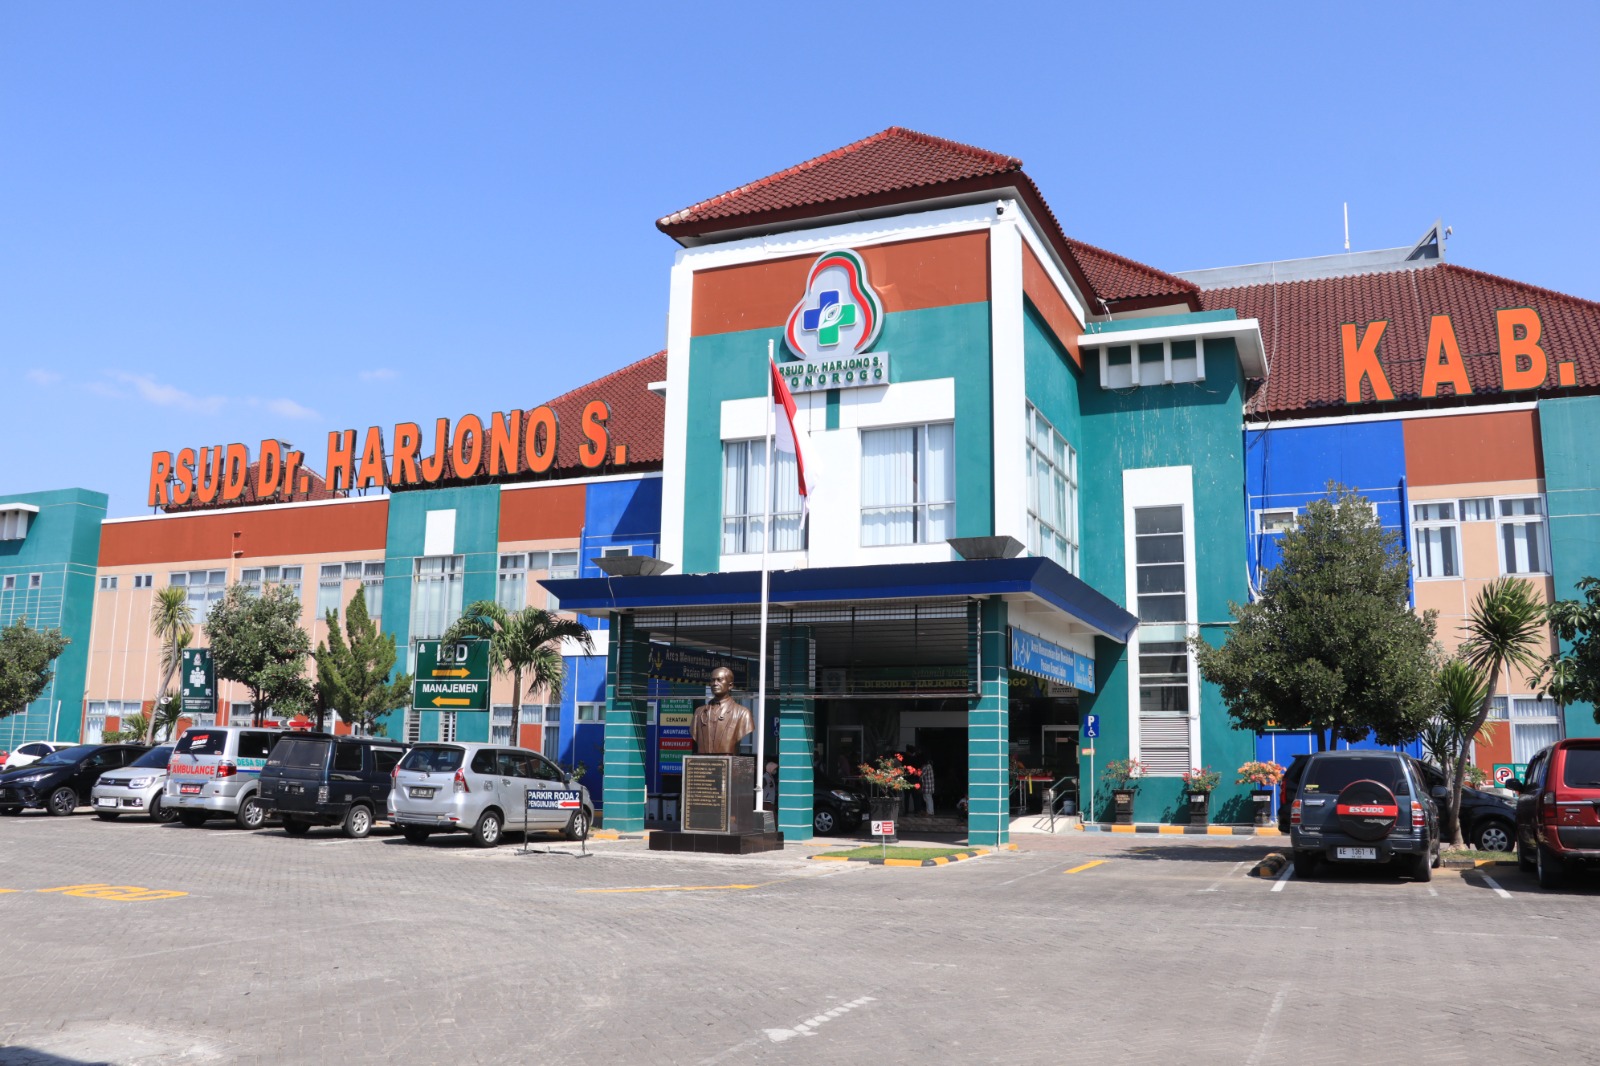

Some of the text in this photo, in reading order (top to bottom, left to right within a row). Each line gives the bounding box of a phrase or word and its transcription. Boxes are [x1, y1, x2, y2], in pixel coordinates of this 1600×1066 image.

[780, 356, 883, 377] RSUD Dr. HARJONO S.
[786, 368, 883, 387] ONOROGO
[148, 400, 629, 507] RSUD Dr. HARJONO S.
[422, 683, 478, 693] MANAJEMEN
[1088, 715, 1095, 727] P
[236, 758, 255, 767] DESA
[172, 764, 215, 775] AMBULANCE
[527, 791, 580, 800] PARKIR RODA 2
[527, 800, 559, 808] PENGUNJUNG
[1338, 847, 1346, 855] AE
